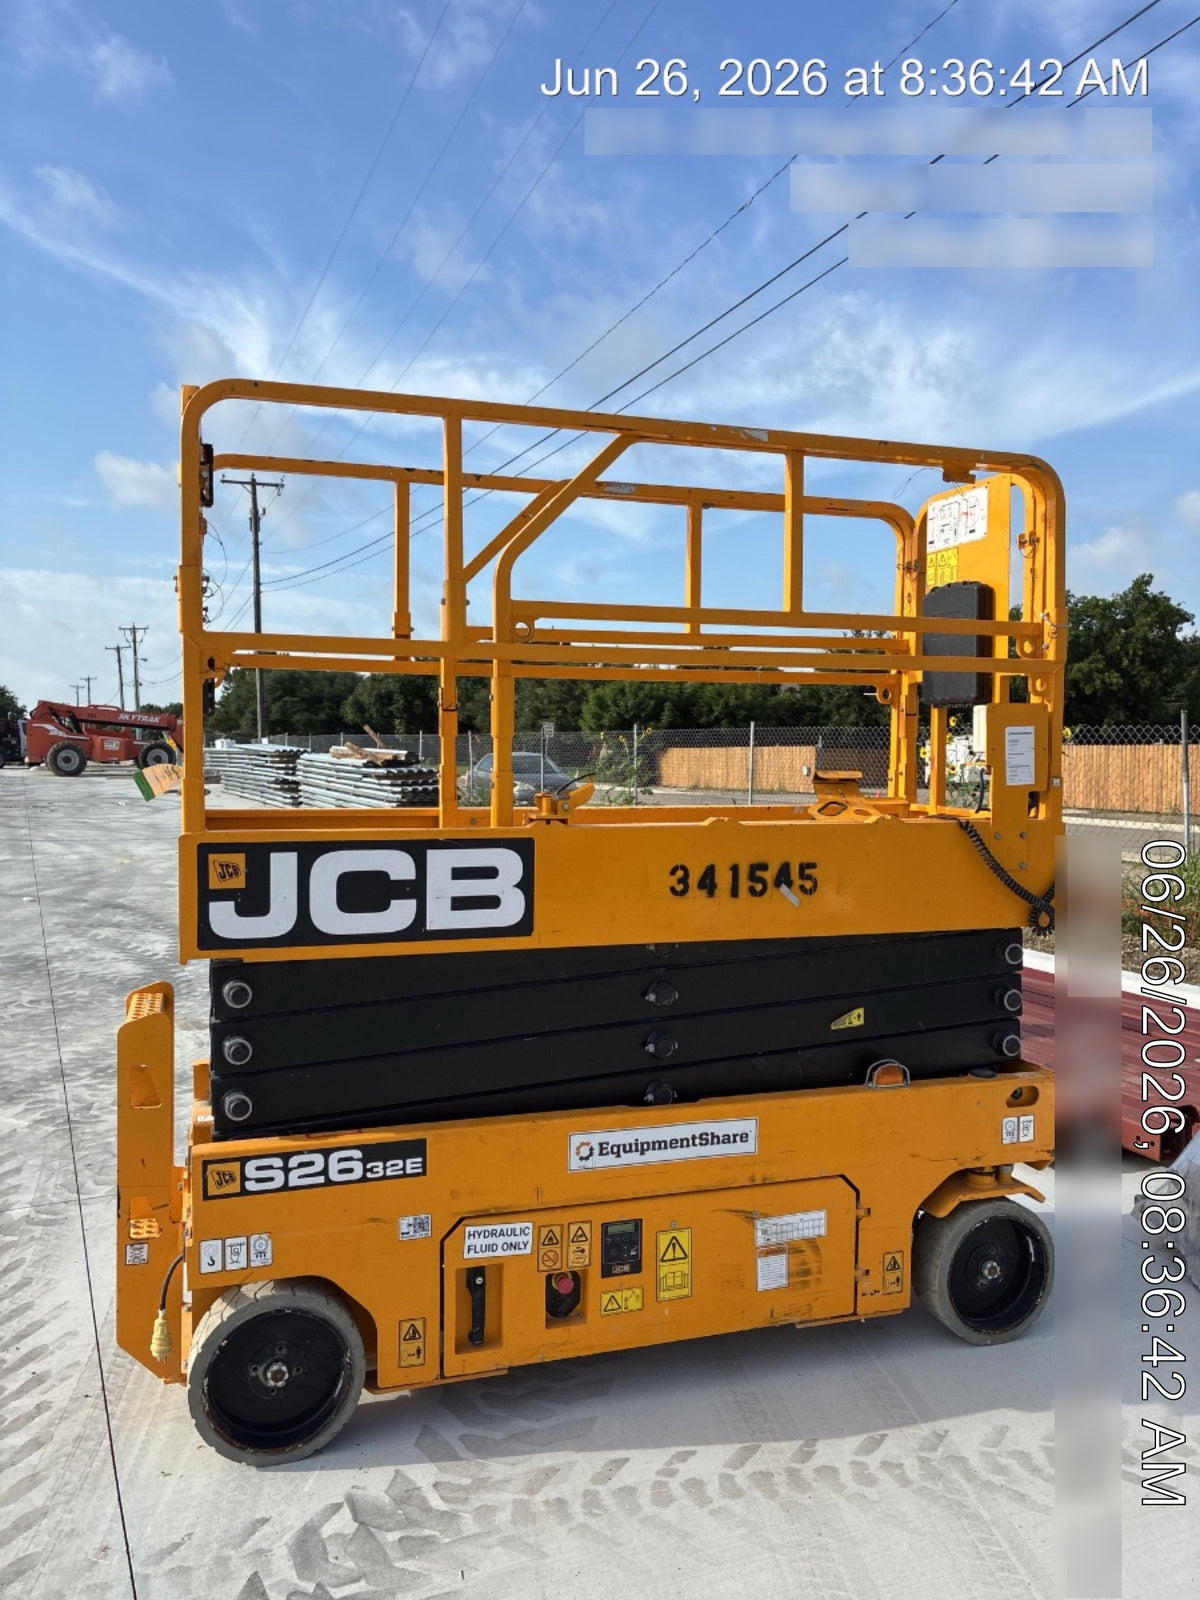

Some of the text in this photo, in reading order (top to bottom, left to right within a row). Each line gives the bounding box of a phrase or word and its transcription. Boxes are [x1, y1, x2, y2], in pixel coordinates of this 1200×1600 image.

[118, 712, 160, 724] SKYTRAK
[216, 860, 241, 882] JCB
[669, 861, 818, 898] 341545
[209, 848, 526, 940] JCB
[598, 1132, 749, 1159] EquipmentShare
[214, 1170, 237, 1188] JCB
[244, 1149, 423, 1192] S26 32E
[467, 1226, 530, 1241] HYDRAULIC
[467, 1240, 529, 1255] FLUID ONLY
